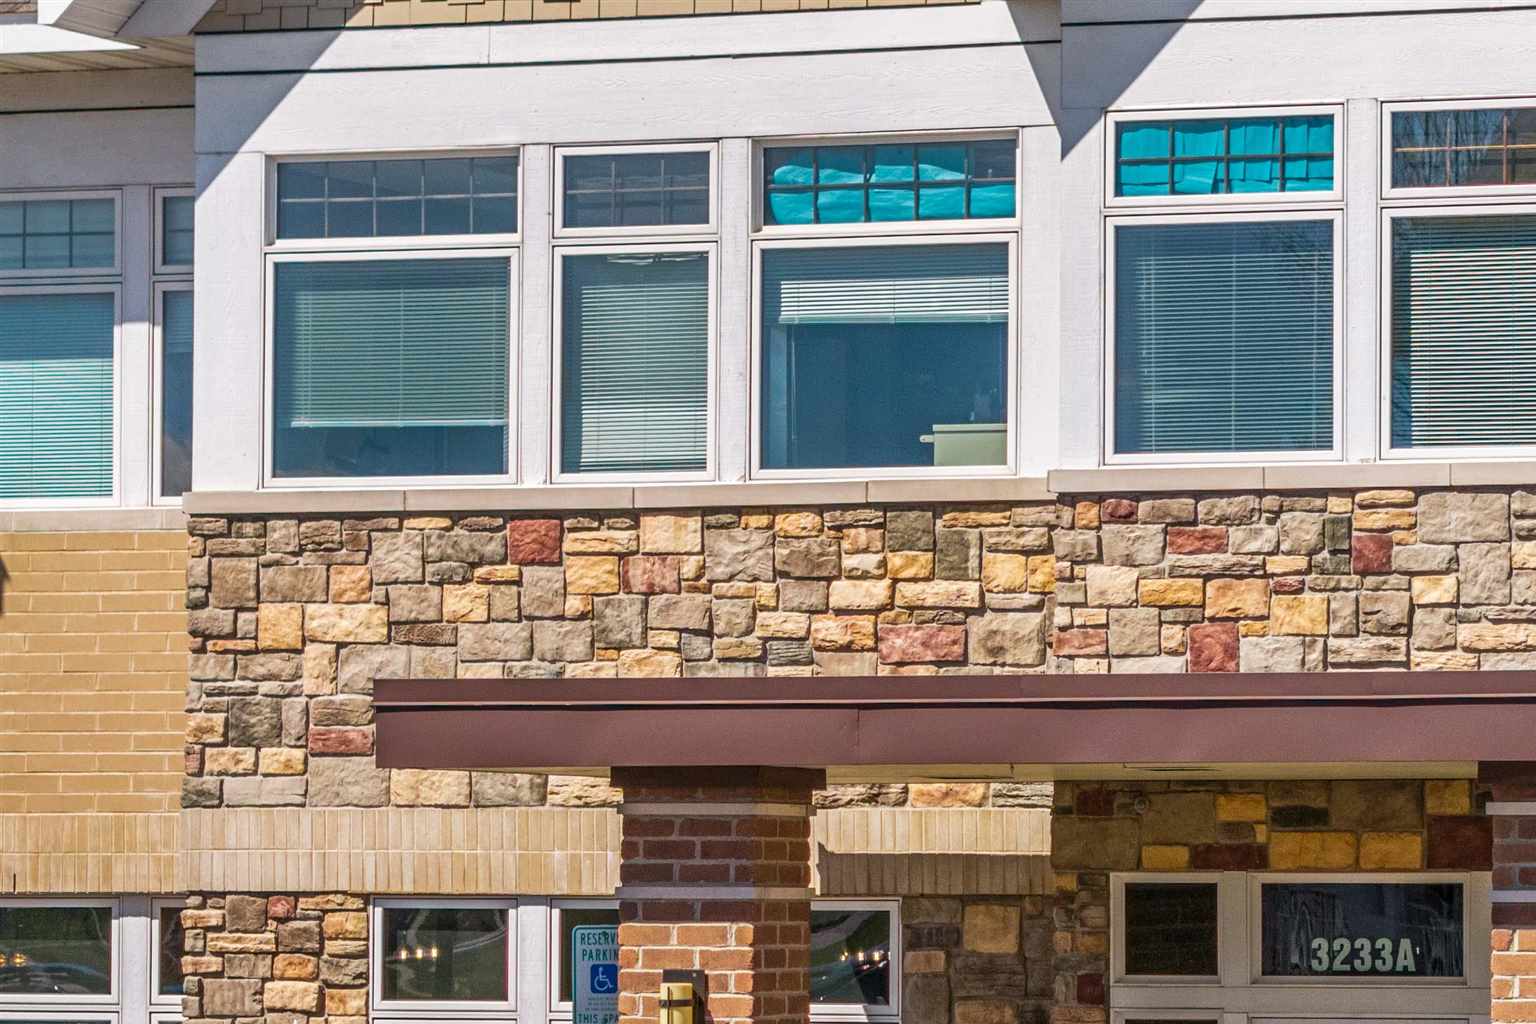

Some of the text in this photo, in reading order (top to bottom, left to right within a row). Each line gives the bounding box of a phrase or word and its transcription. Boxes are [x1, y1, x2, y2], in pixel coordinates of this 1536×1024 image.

[580, 932, 618, 946] RESERV
[582, 949, 618, 961] PARKIN
[1311, 937, 1416, 972] 3233A
[578, 1013, 618, 1024] THIS SPA
